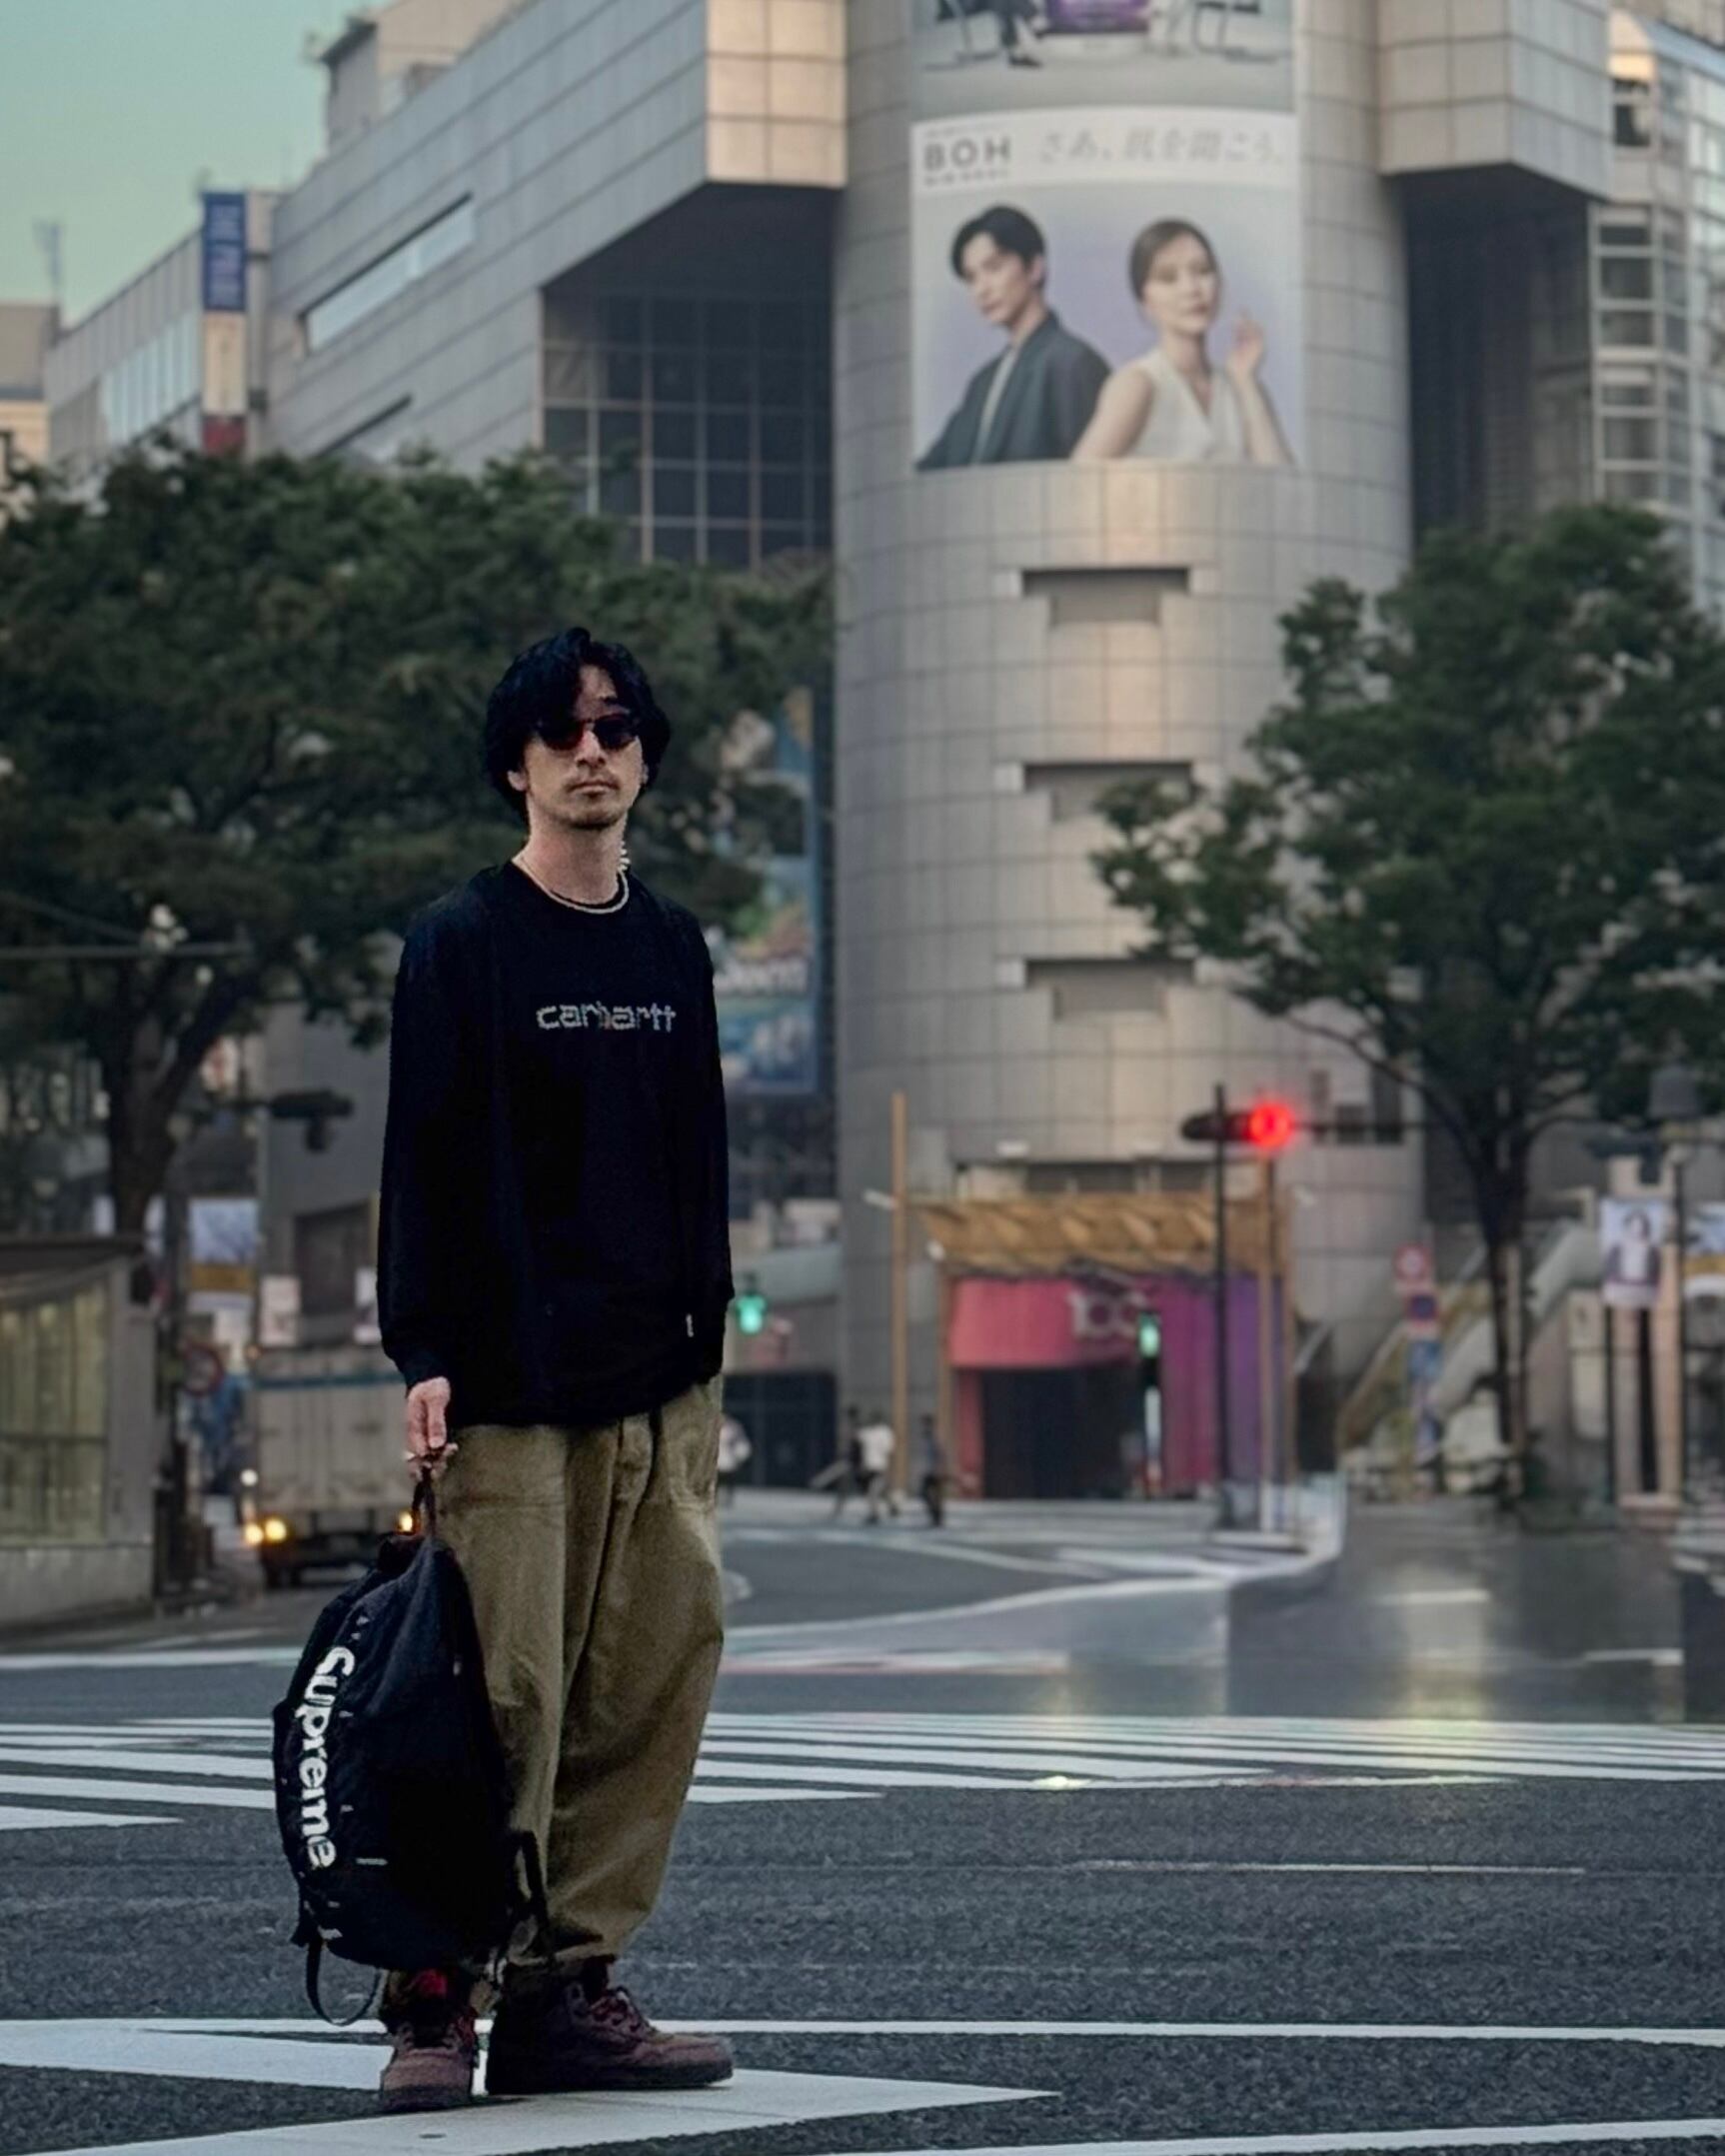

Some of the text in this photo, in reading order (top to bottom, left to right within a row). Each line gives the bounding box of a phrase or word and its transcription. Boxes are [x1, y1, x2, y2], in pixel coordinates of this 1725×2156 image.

[924, 136, 1011, 170] BOH
[536, 1001, 677, 1034] carhartt
[295, 1645, 356, 1869] Supreme
